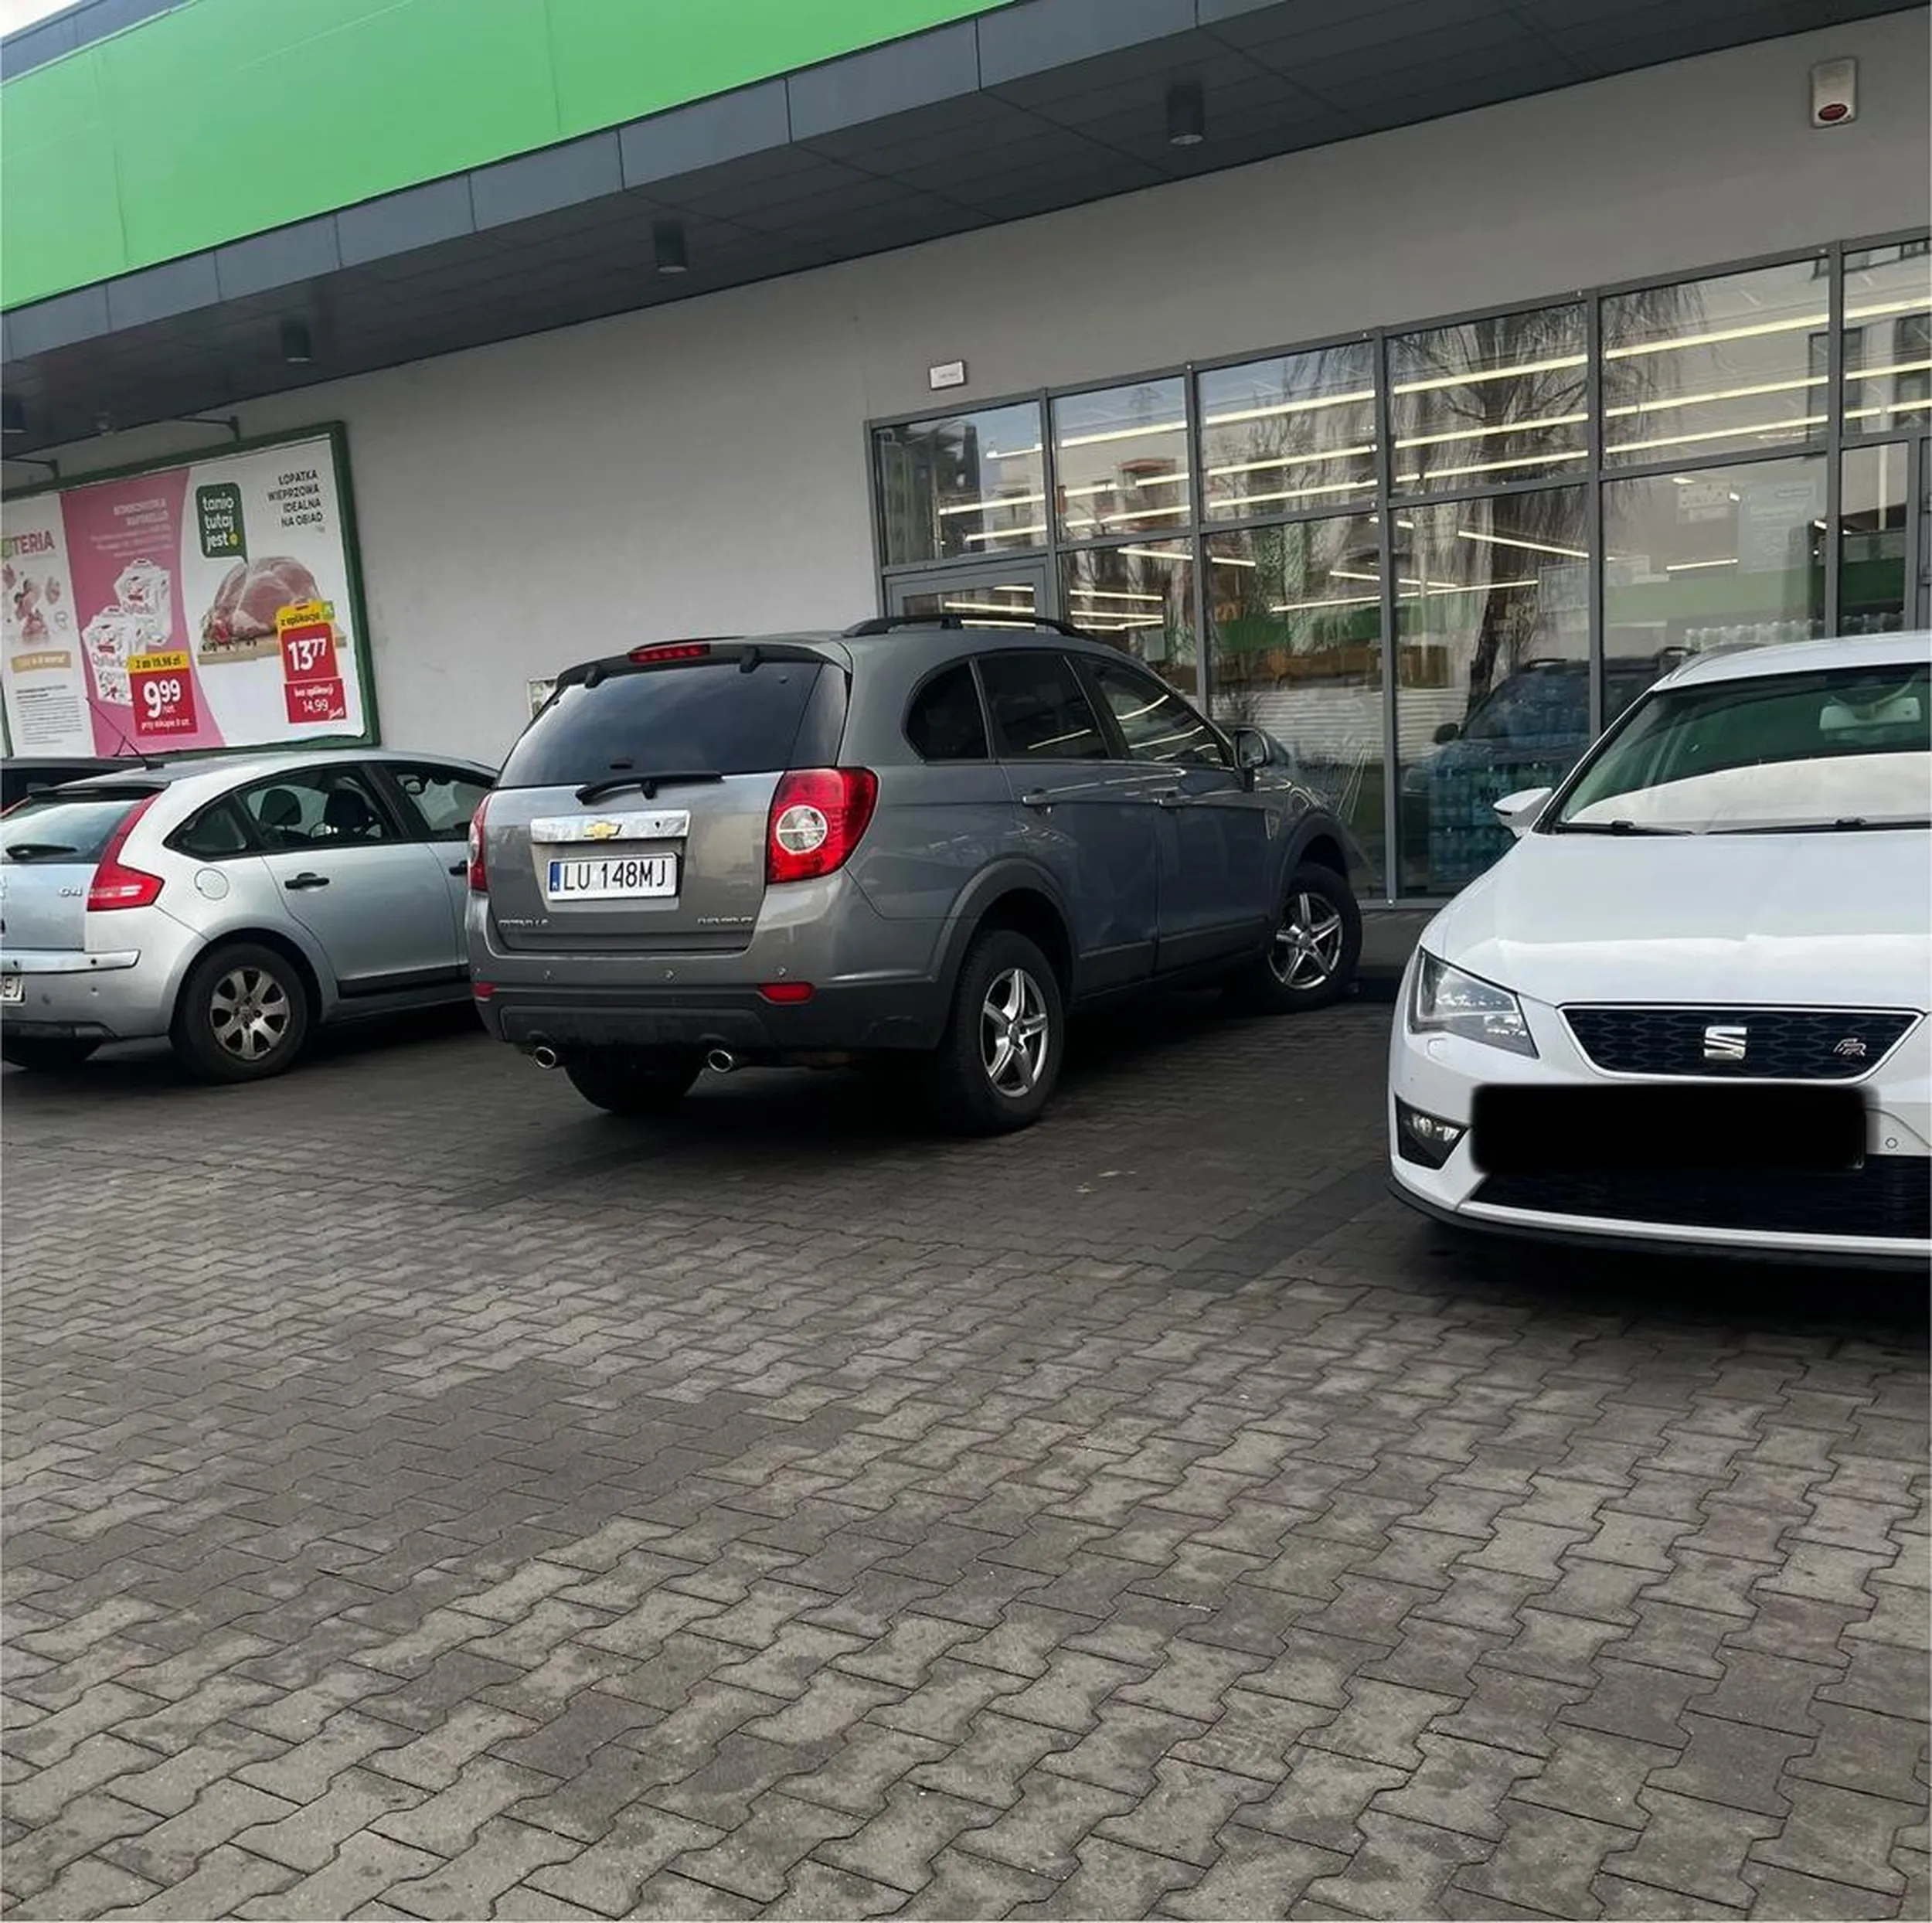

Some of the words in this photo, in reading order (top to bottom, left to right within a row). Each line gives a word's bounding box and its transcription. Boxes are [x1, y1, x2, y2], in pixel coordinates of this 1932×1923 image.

[202, 492, 235, 511] tanio
[205, 511, 234, 533] tutaj
[206, 530, 230, 553] jest
[564, 863, 590, 890] LU
[601, 859, 665, 888] 148MJ
